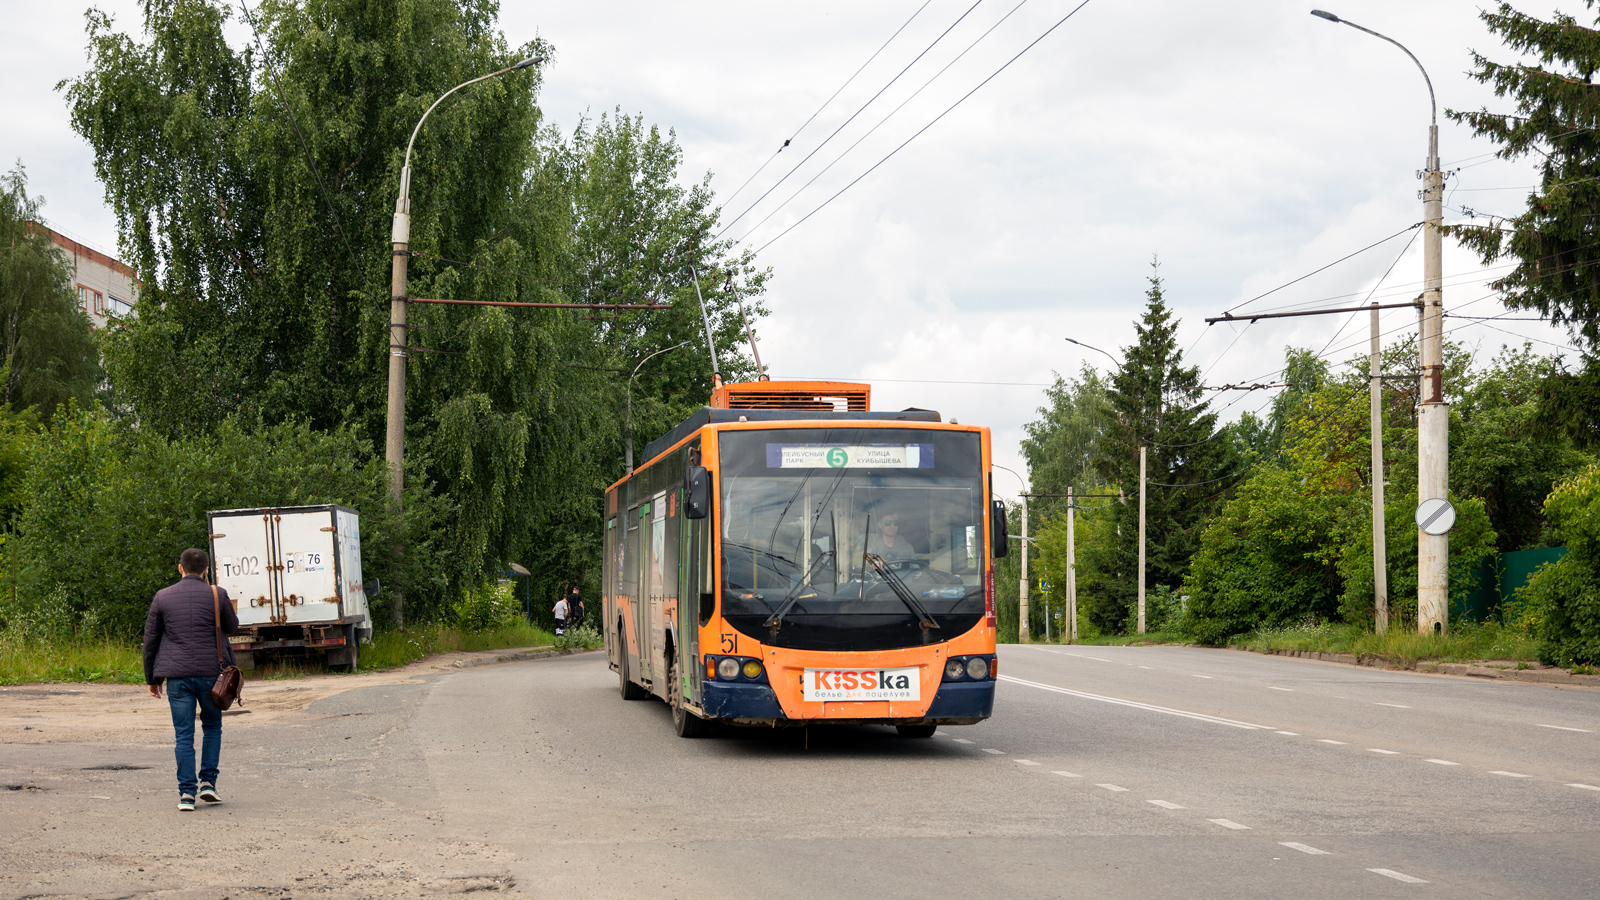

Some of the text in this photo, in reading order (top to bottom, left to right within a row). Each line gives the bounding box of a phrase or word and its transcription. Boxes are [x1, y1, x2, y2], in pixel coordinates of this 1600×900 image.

[832, 449, 844, 466] 5
[307, 553, 321, 564] 76
[721, 633, 738, 654] 51
